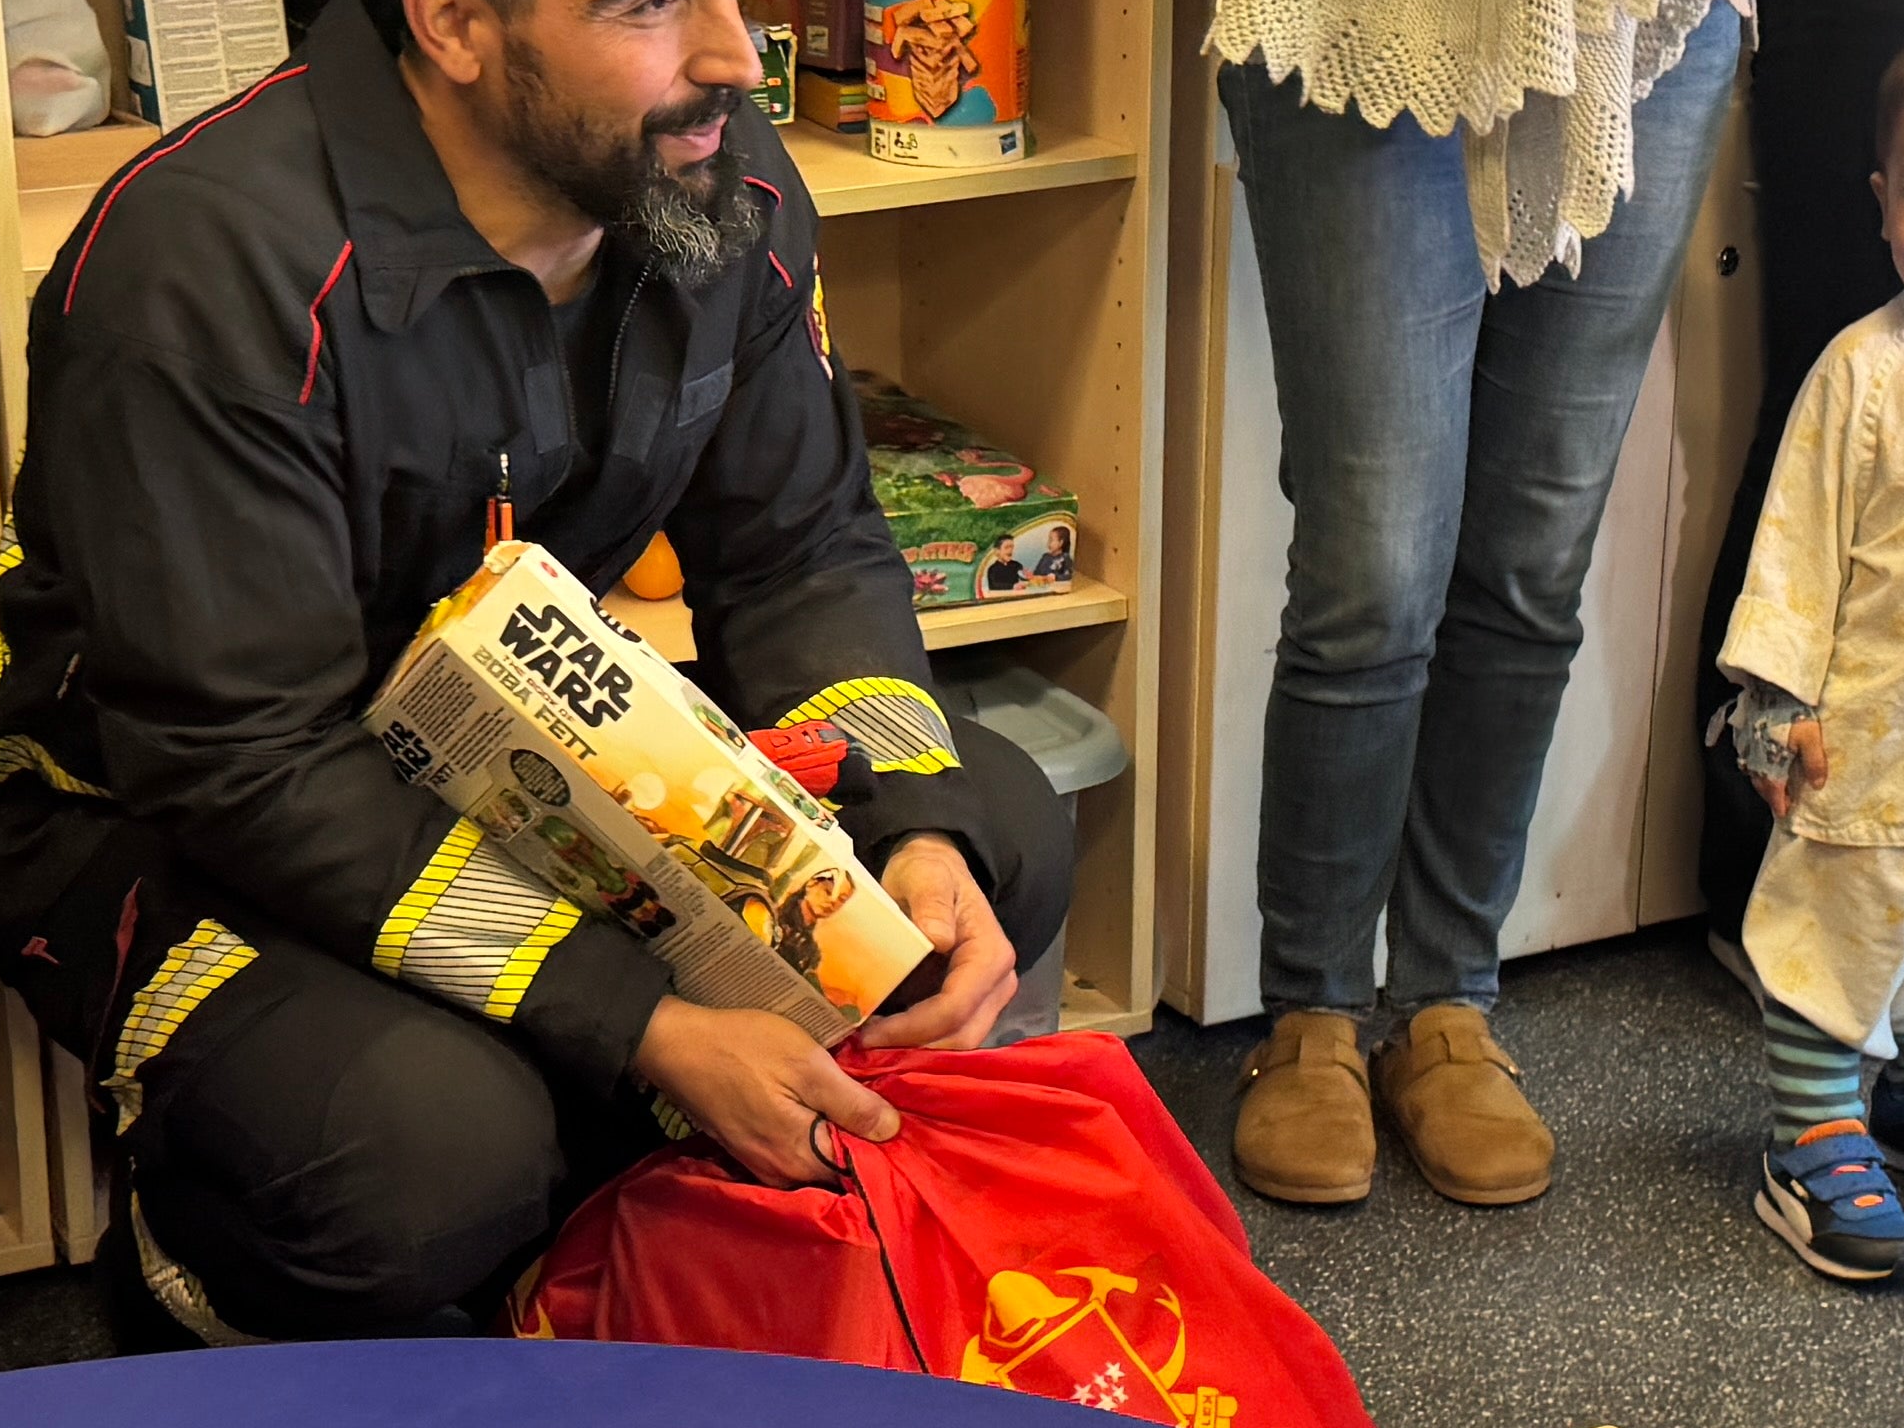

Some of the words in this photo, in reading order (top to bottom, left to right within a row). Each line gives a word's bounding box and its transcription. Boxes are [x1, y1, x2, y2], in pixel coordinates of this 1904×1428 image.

[499, 612, 622, 728] WARS
[515, 602, 633, 713] STAR
[534, 704, 598, 761] FETT
